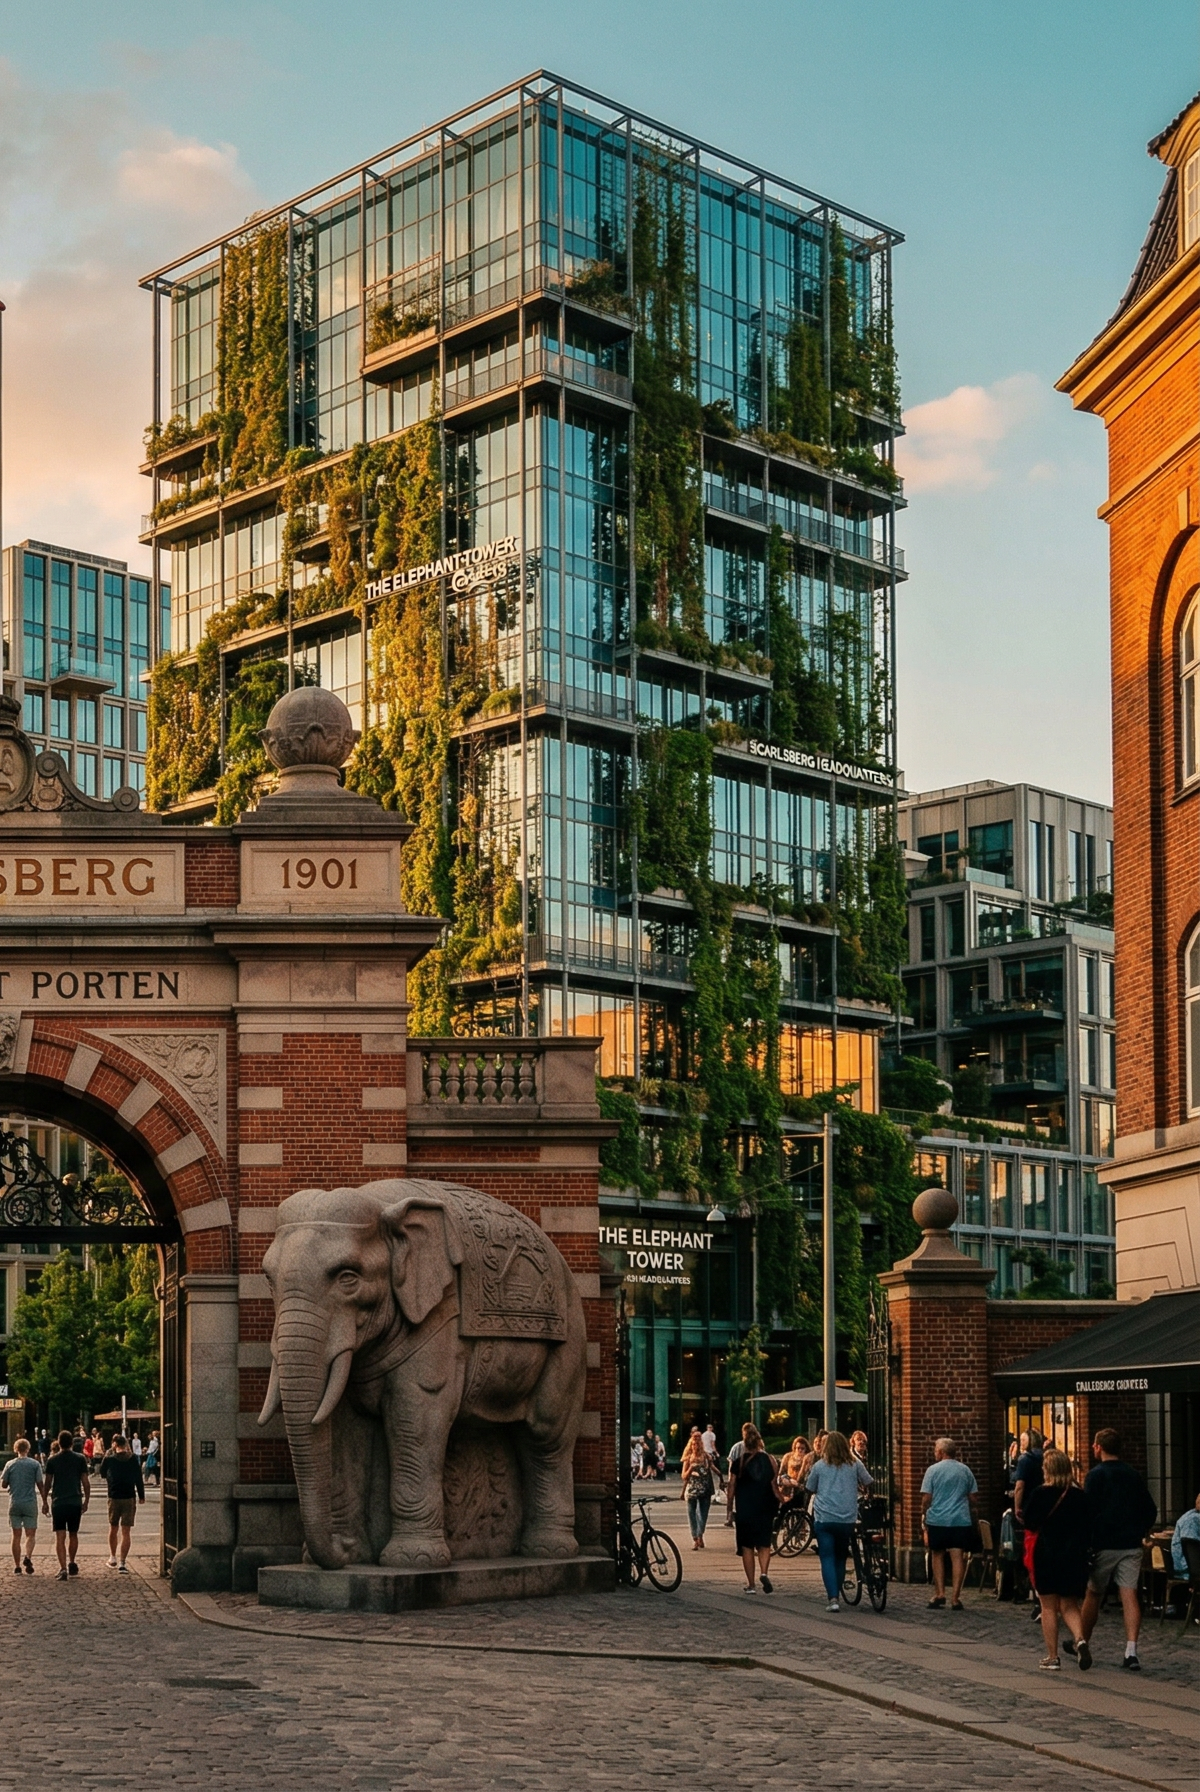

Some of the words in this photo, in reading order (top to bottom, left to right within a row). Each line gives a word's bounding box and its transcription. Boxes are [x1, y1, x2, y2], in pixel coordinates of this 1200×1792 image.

[365, 576, 391, 599] THE
[393, 553, 463, 591] ELEPHANT
[464, 536, 516, 566] TOWER
[281, 857, 359, 890] 1901
[31, 970, 181, 1000] PORTEN
[599, 1226, 628, 1245] THE
[632, 1228, 714, 1250] ELEPHANT
[627, 1250, 684, 1271] TOWER
